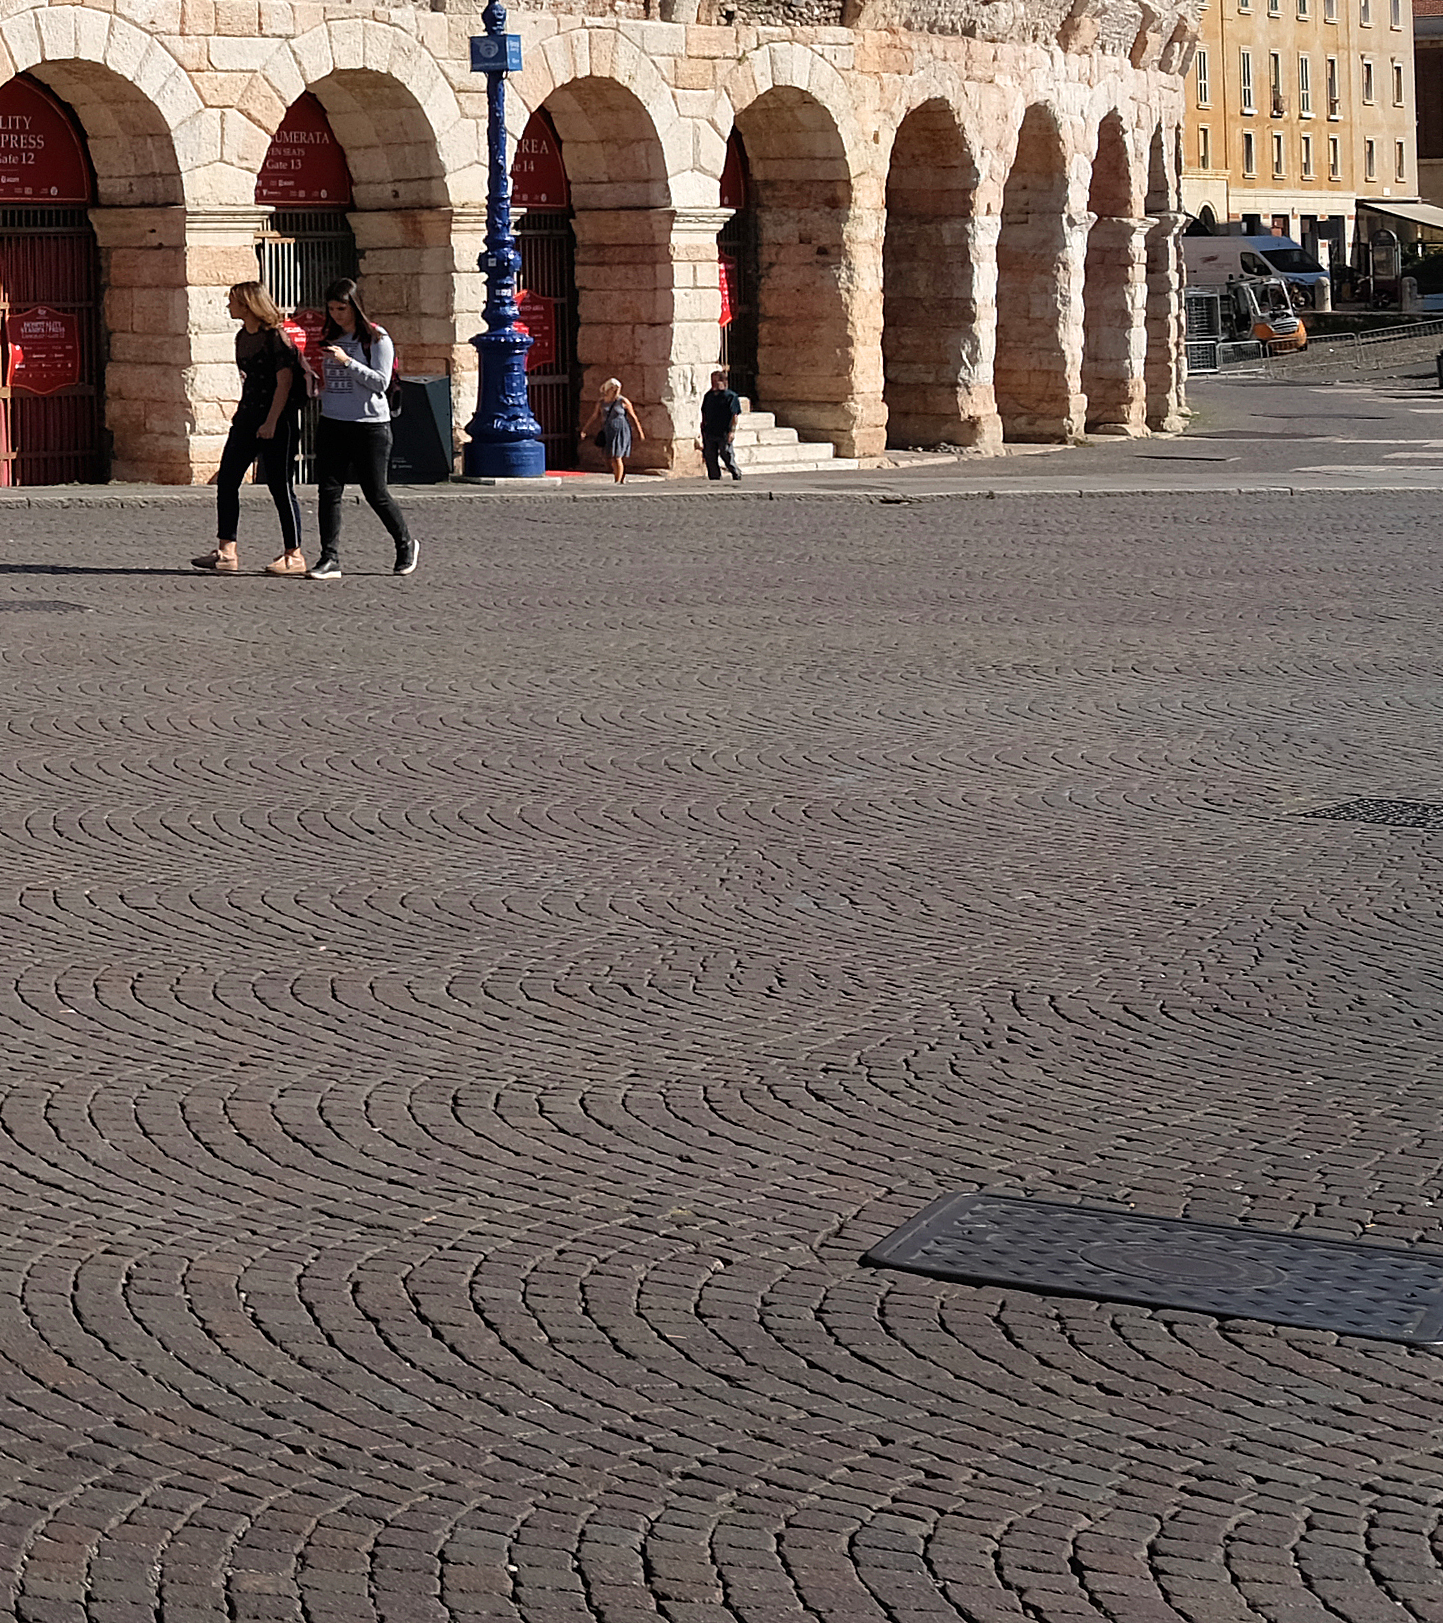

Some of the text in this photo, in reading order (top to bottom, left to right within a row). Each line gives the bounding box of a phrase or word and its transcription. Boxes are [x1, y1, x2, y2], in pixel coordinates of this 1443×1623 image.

[0, 134, 45, 149] PRESS
[21, 152, 35, 164] 12
[266, 159, 302, 170] Gate 13
[523, 161, 535, 172] 14
